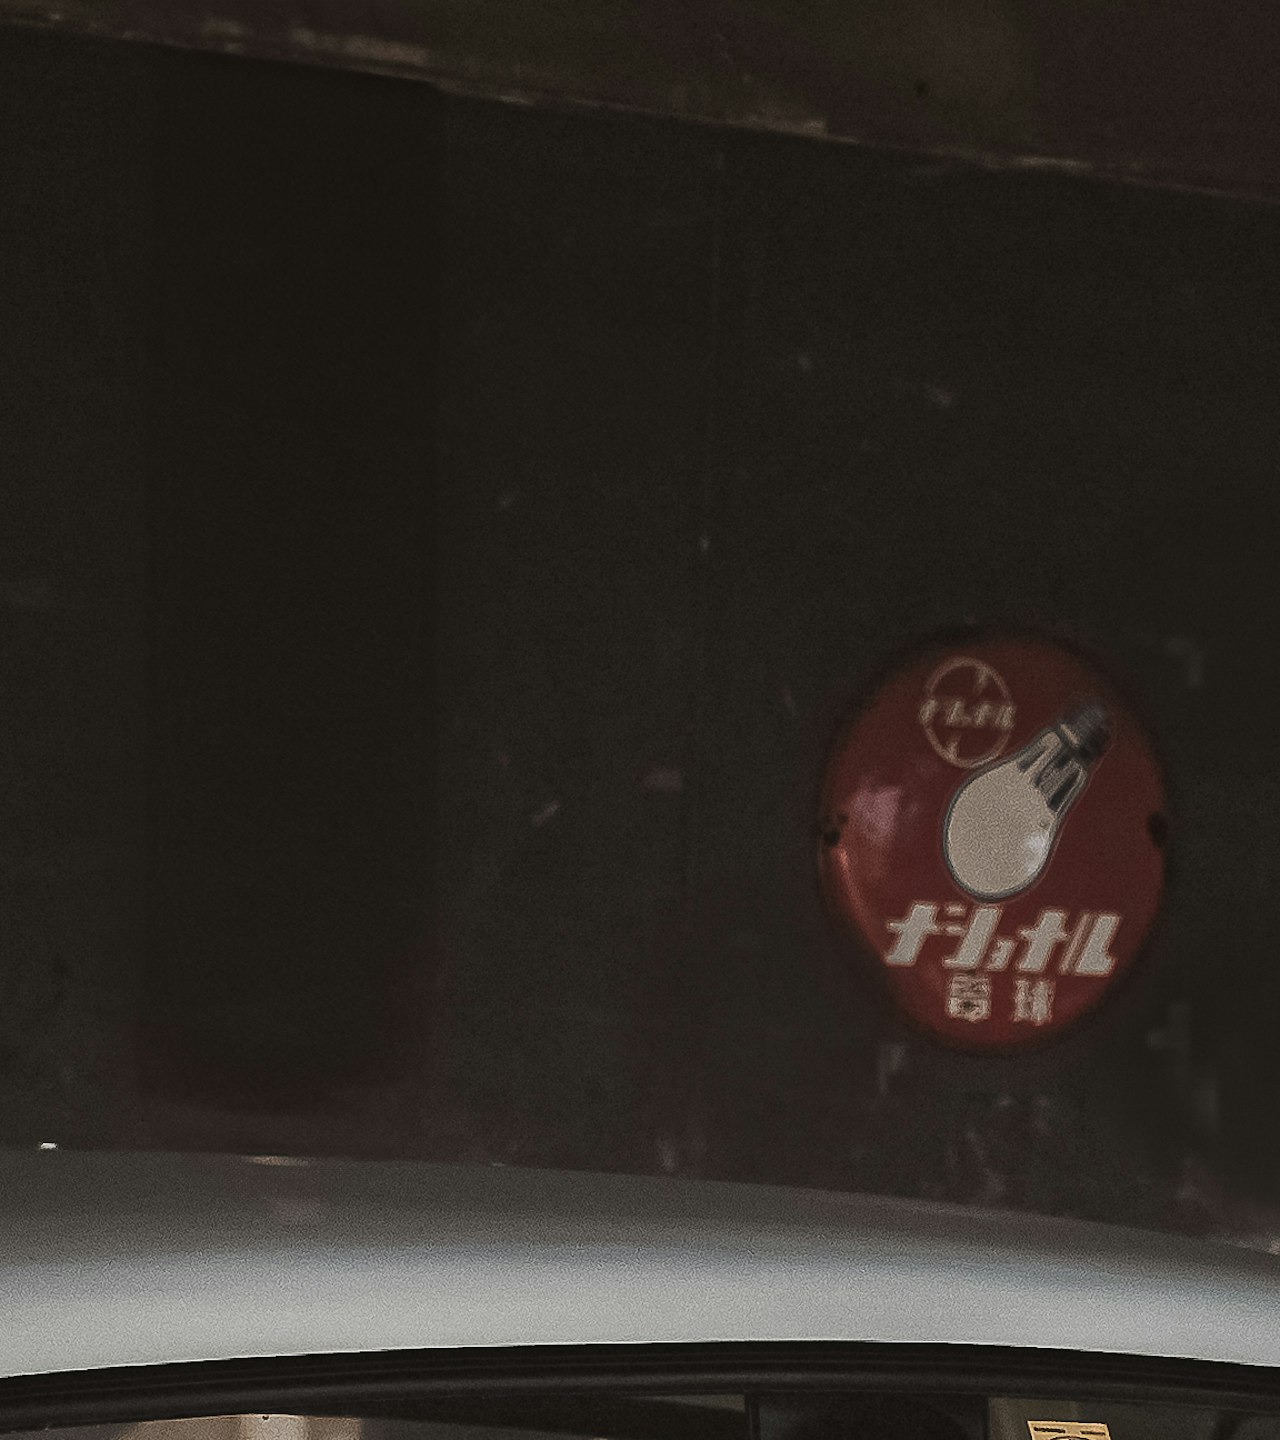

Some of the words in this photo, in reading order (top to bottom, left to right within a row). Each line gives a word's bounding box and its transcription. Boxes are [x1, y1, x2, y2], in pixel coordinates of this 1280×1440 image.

[884, 902, 1122, 976] ナショナル
